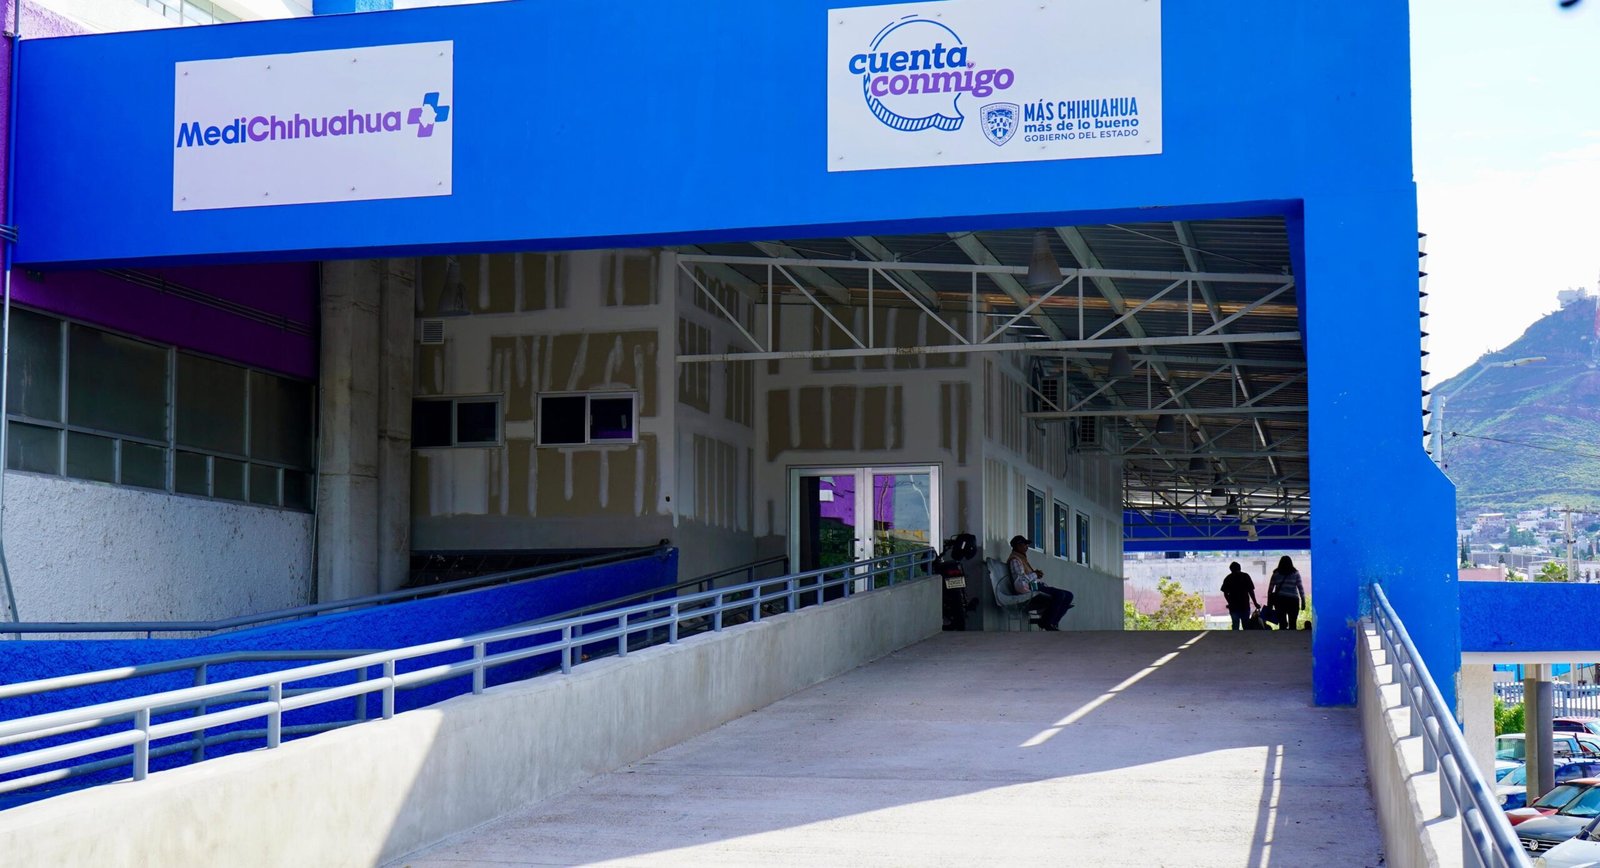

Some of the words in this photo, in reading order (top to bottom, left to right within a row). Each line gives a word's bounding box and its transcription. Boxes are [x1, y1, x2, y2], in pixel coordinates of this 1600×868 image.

[848, 43, 968, 75] cuenta
[870, 63, 1014, 98] conmigo
[1024, 99, 1054, 122] MÁS
[1058, 97, 1138, 120] CHIHUAHUA
[176, 109, 402, 148] MediChihuahua
[1024, 121, 1052, 133] más
[1056, 120, 1074, 131] de
[1077, 119, 1091, 130] lo
[1095, 118, 1139, 129] bueno
[1024, 132, 1075, 142] GOBIERNO
[1078, 131, 1097, 139] DEL
[1100, 128, 1139, 138] ESTADO
